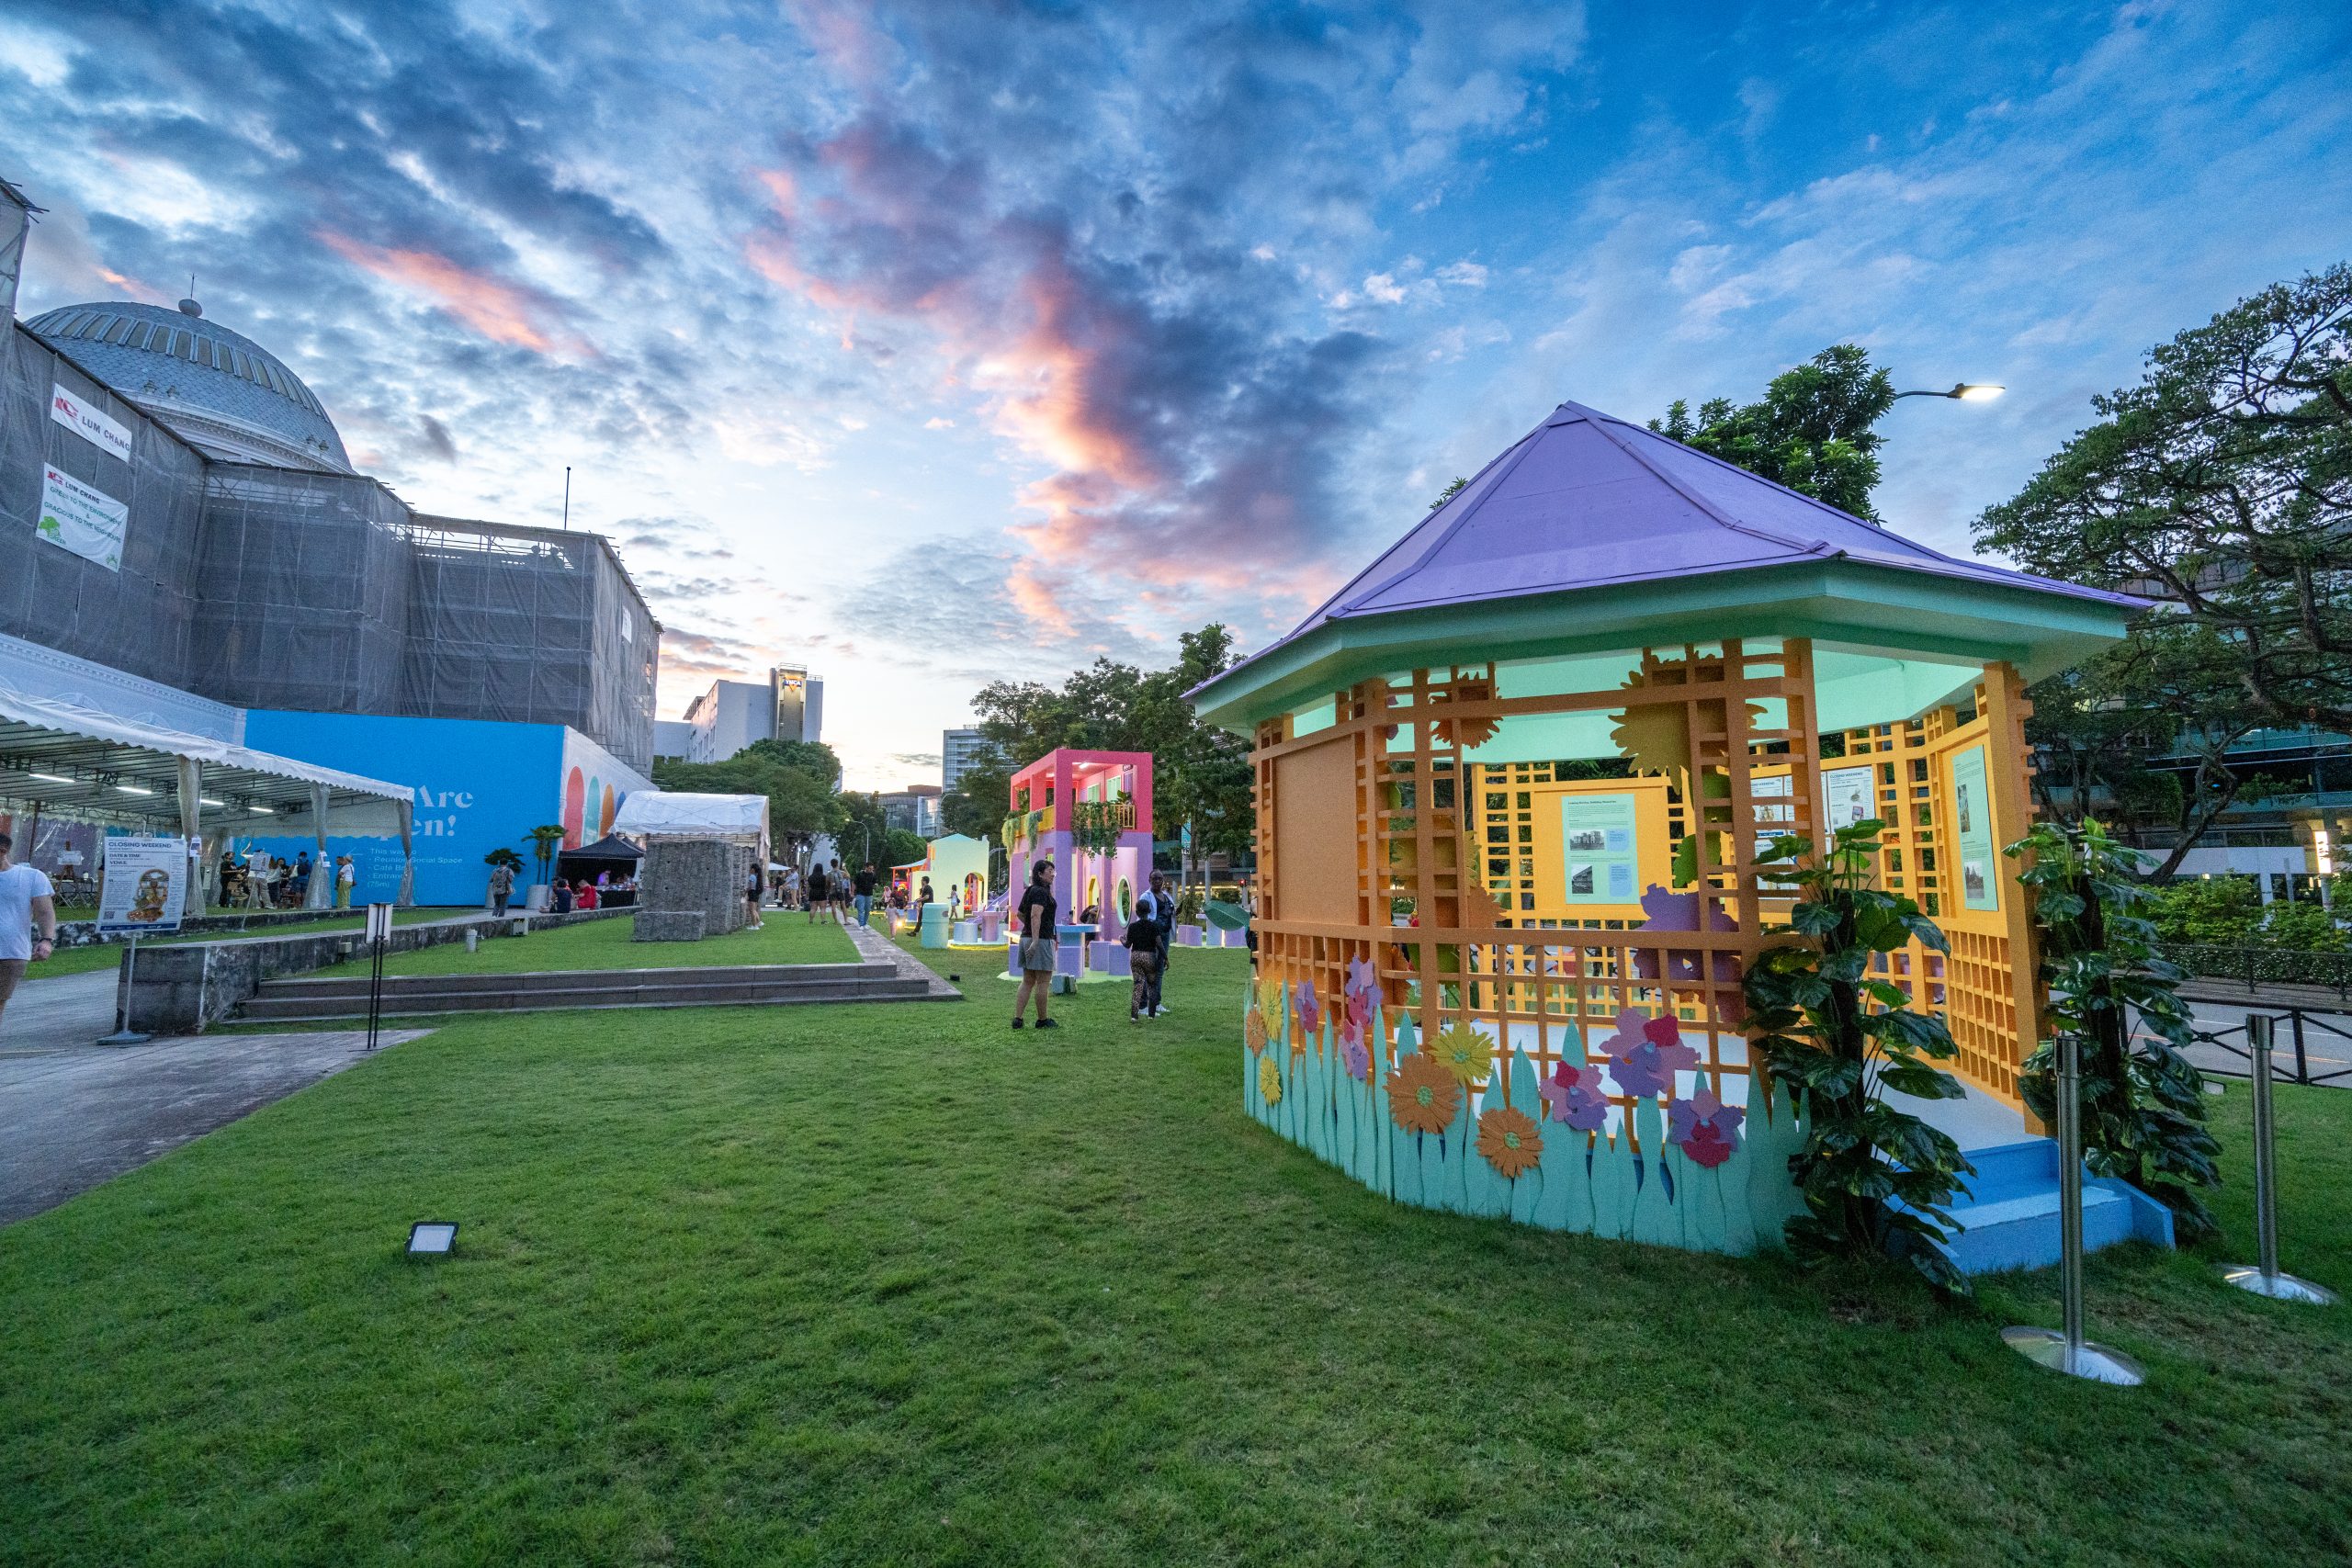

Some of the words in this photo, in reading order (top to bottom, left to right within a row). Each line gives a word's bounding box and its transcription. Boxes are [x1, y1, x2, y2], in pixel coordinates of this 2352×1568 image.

[82, 415, 101, 434] LUM
[104, 429, 130, 451] CHANG
[65, 481, 79, 493] LUM
[80, 490, 100, 504] CHANG
[70, 495, 77, 504] TO
[75, 515, 84, 524] TO
[413, 784, 474, 808] Are
